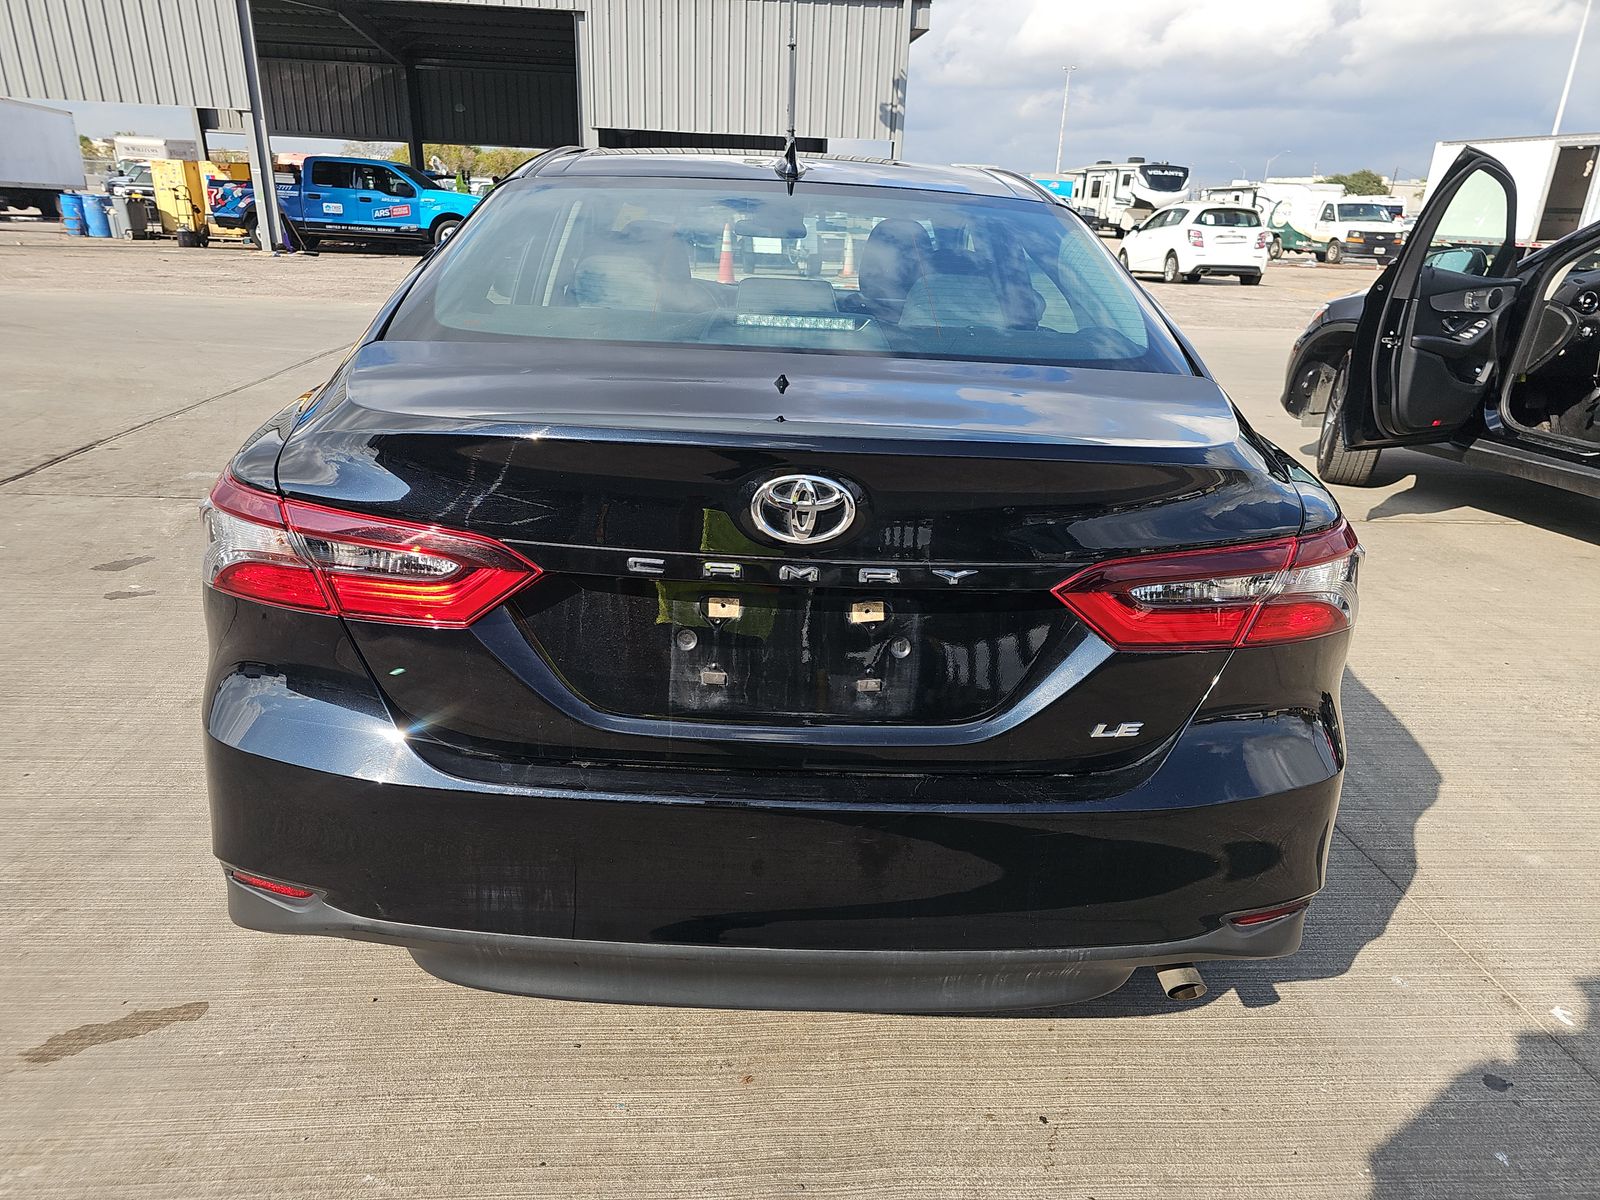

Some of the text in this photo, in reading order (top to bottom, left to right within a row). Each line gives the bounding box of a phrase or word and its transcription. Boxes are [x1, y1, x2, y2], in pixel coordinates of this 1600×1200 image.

[1147, 169, 1184, 177] VOLANTE
[374, 209, 390, 218] ARS
[627, 556, 980, 585] CAMRY
[1090, 722, 1145, 738] LE
